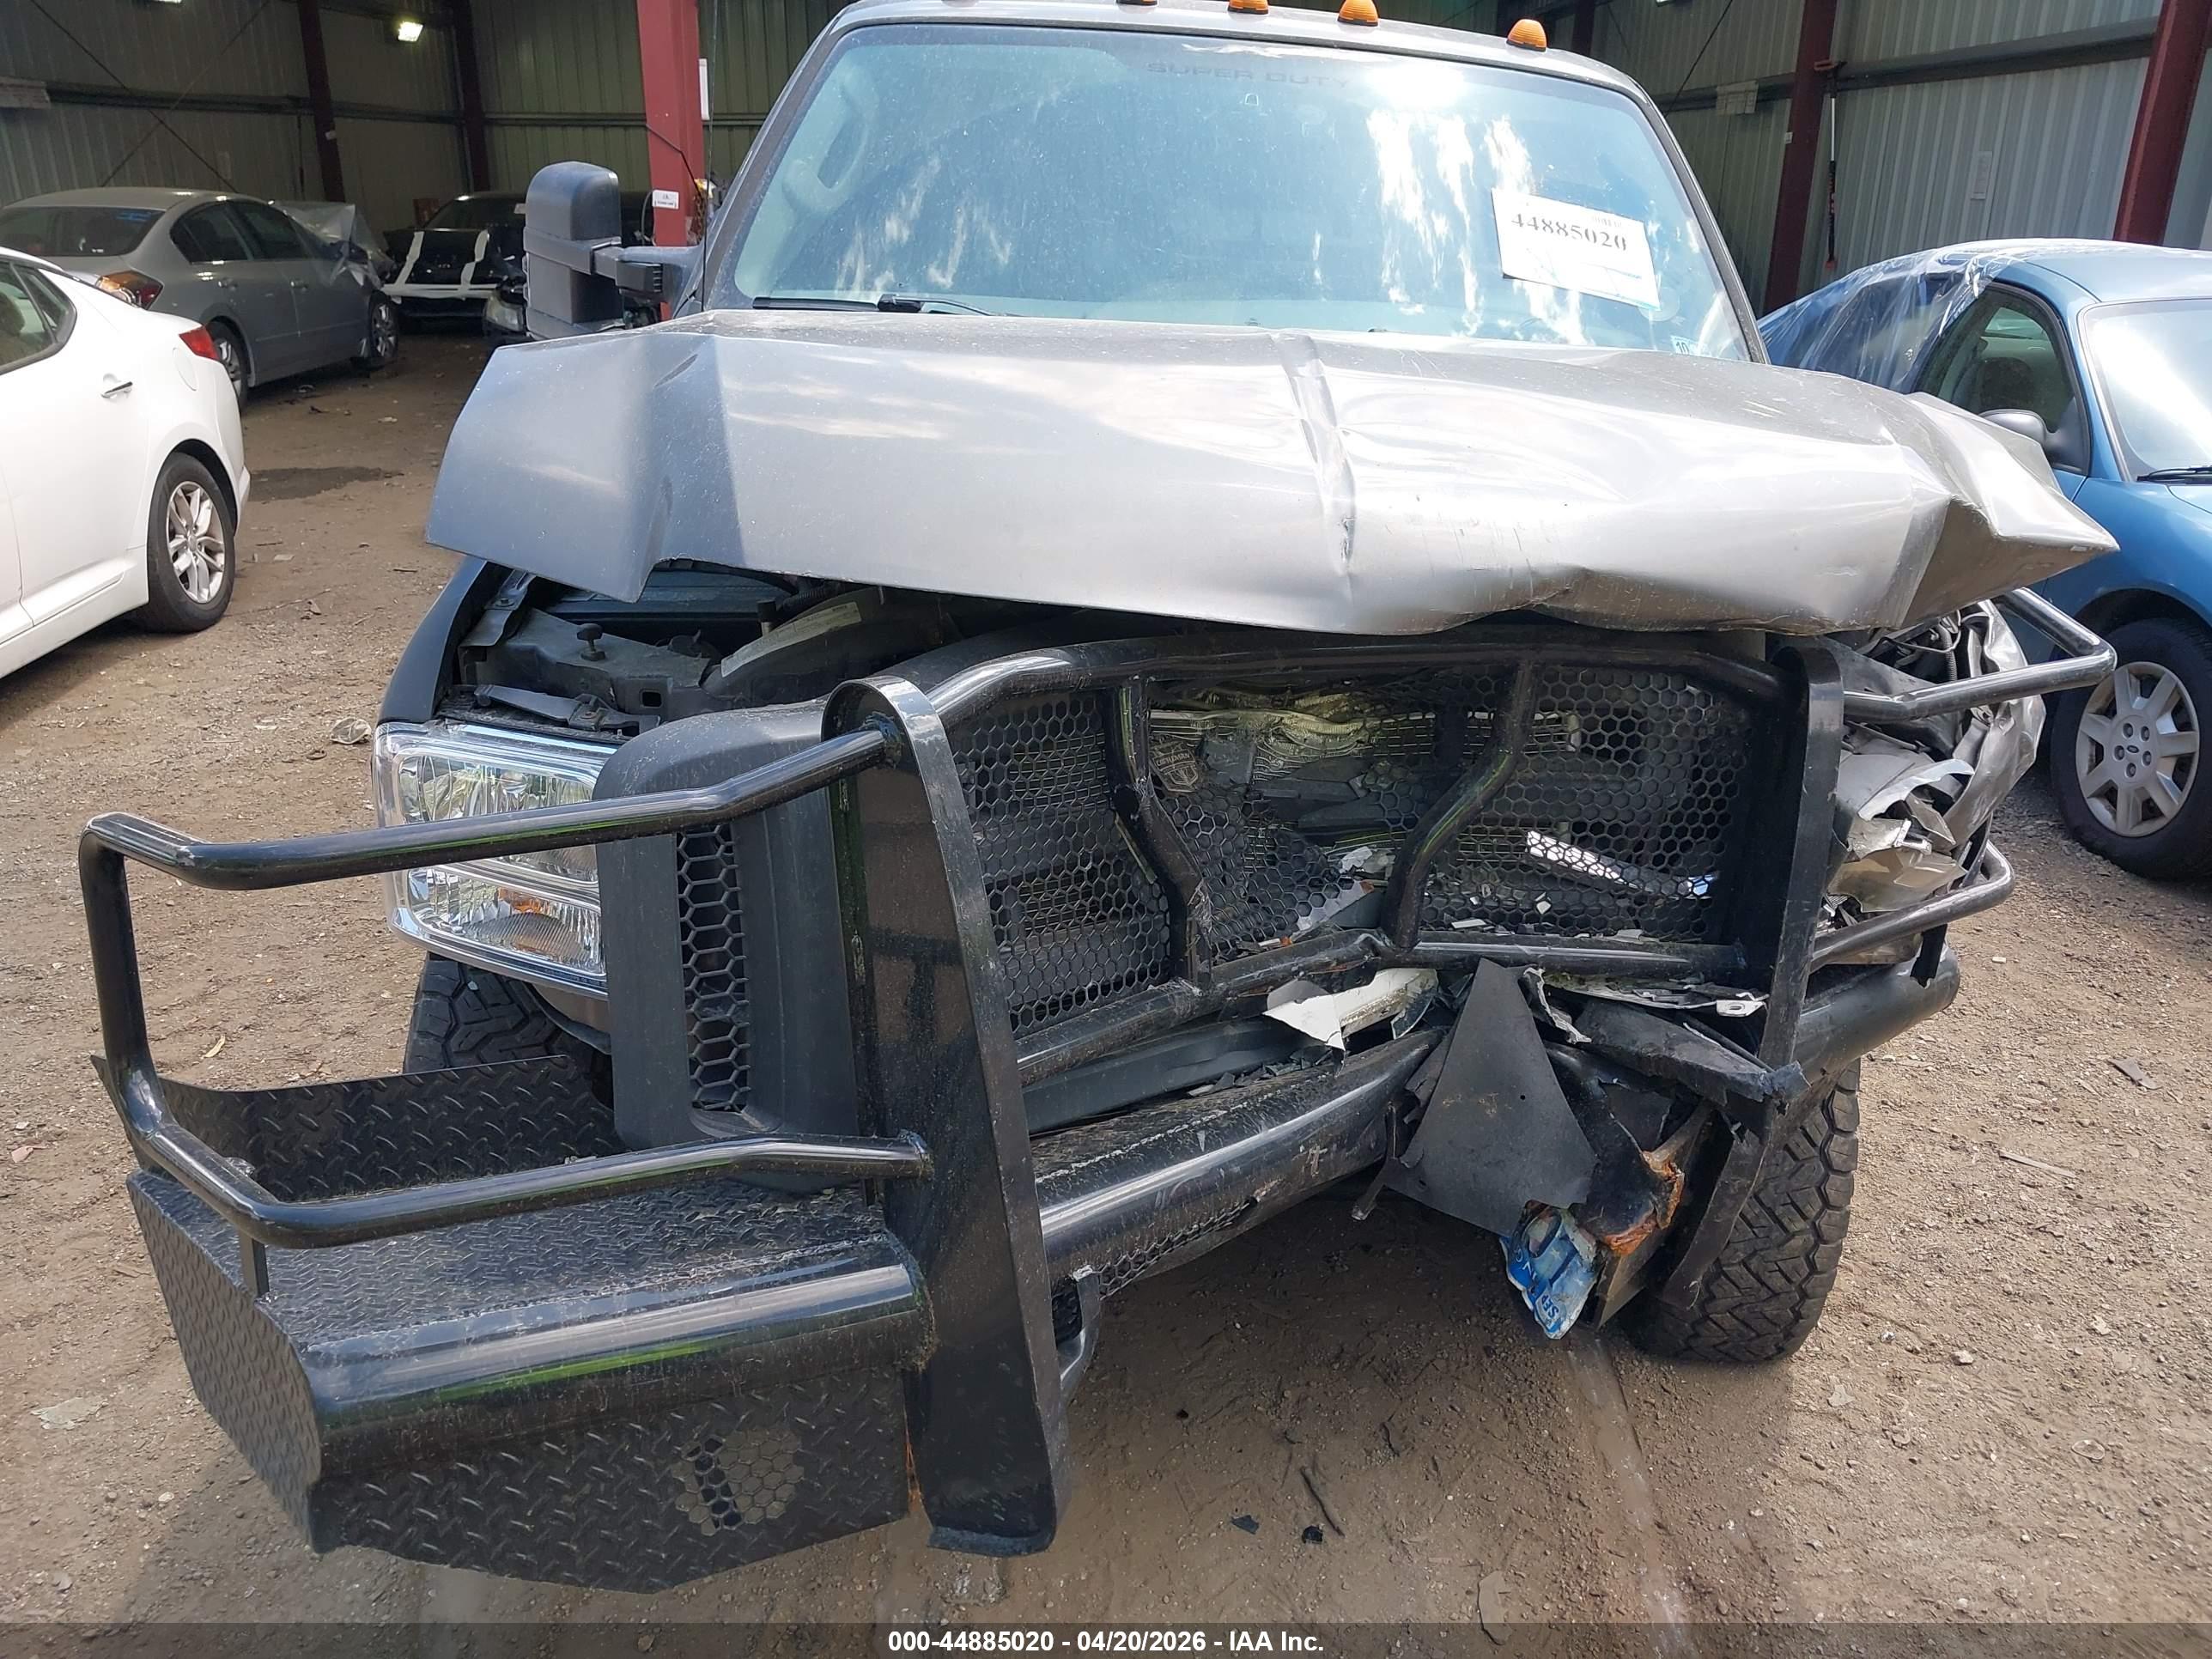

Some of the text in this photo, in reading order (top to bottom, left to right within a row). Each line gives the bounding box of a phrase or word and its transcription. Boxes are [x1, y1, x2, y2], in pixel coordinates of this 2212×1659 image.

[1146, 62, 1348, 88] SUPER DUTY
[1511, 213, 1626, 251] 44885020
[1540, 1294, 1559, 1317] SEP
